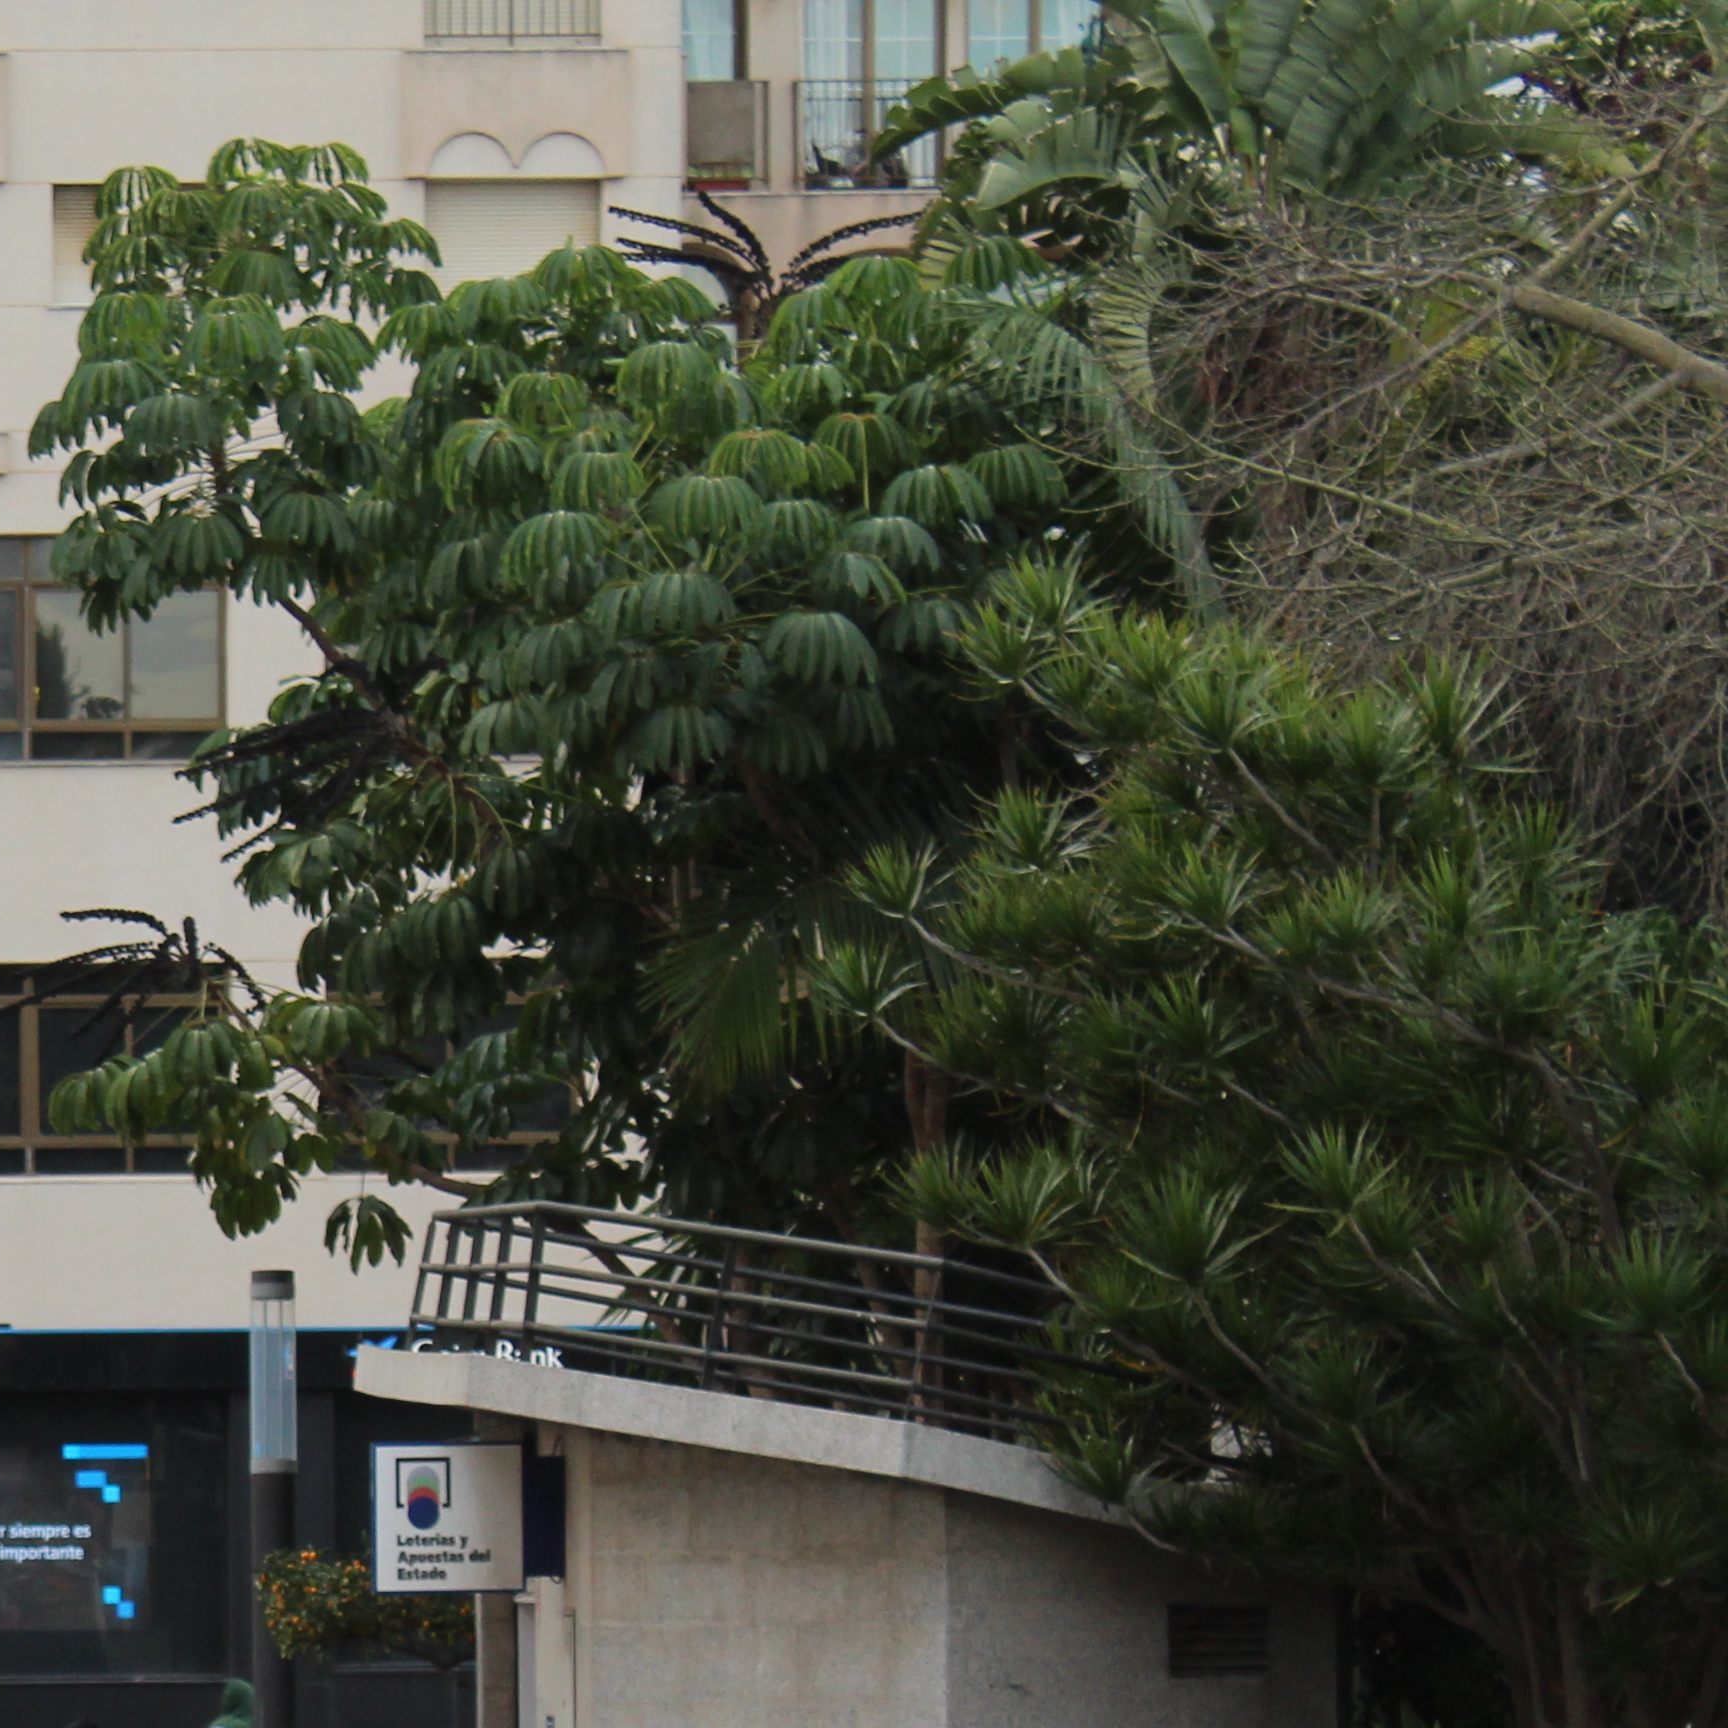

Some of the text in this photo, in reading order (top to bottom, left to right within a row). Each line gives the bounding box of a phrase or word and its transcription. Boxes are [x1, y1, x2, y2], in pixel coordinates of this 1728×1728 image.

[8, 1521, 71, 1541] siempre
[72, 1524, 92, 1539] es
[461, 1535, 469, 1549] y
[397, 1549, 491, 1566] Apuestas del
[397, 1566, 447, 1581] Estado
